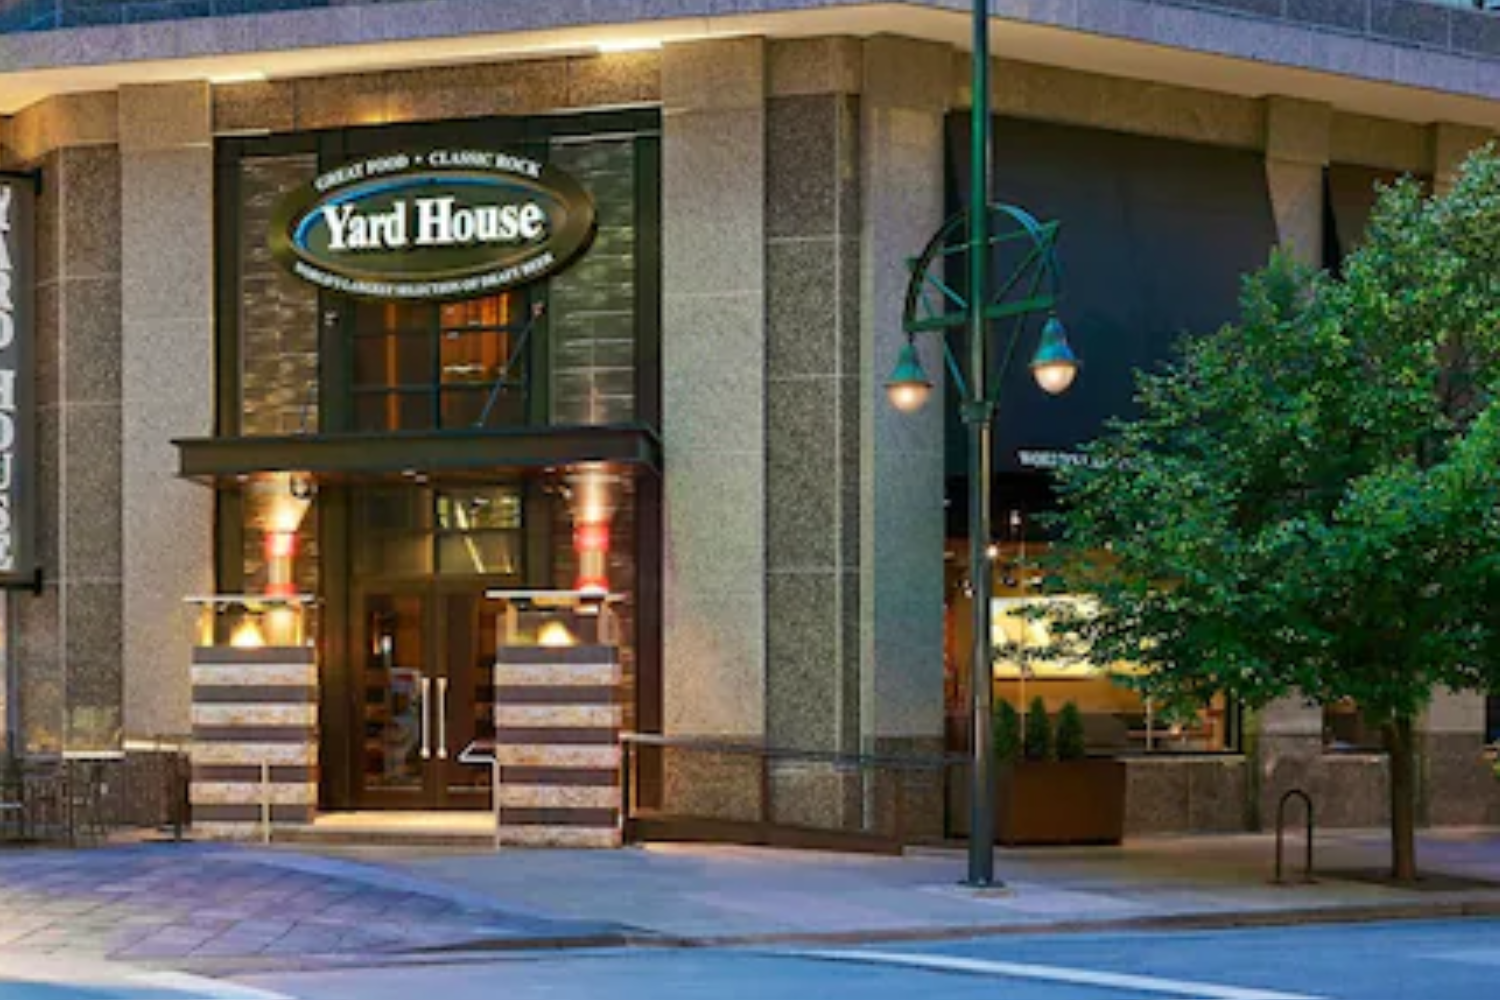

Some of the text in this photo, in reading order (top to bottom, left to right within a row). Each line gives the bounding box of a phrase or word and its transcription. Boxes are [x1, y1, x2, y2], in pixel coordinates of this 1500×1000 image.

[316, 151, 542, 190] GREAT FOOD CLASSIC ROCK
[322, 197, 543, 250] Yard House
